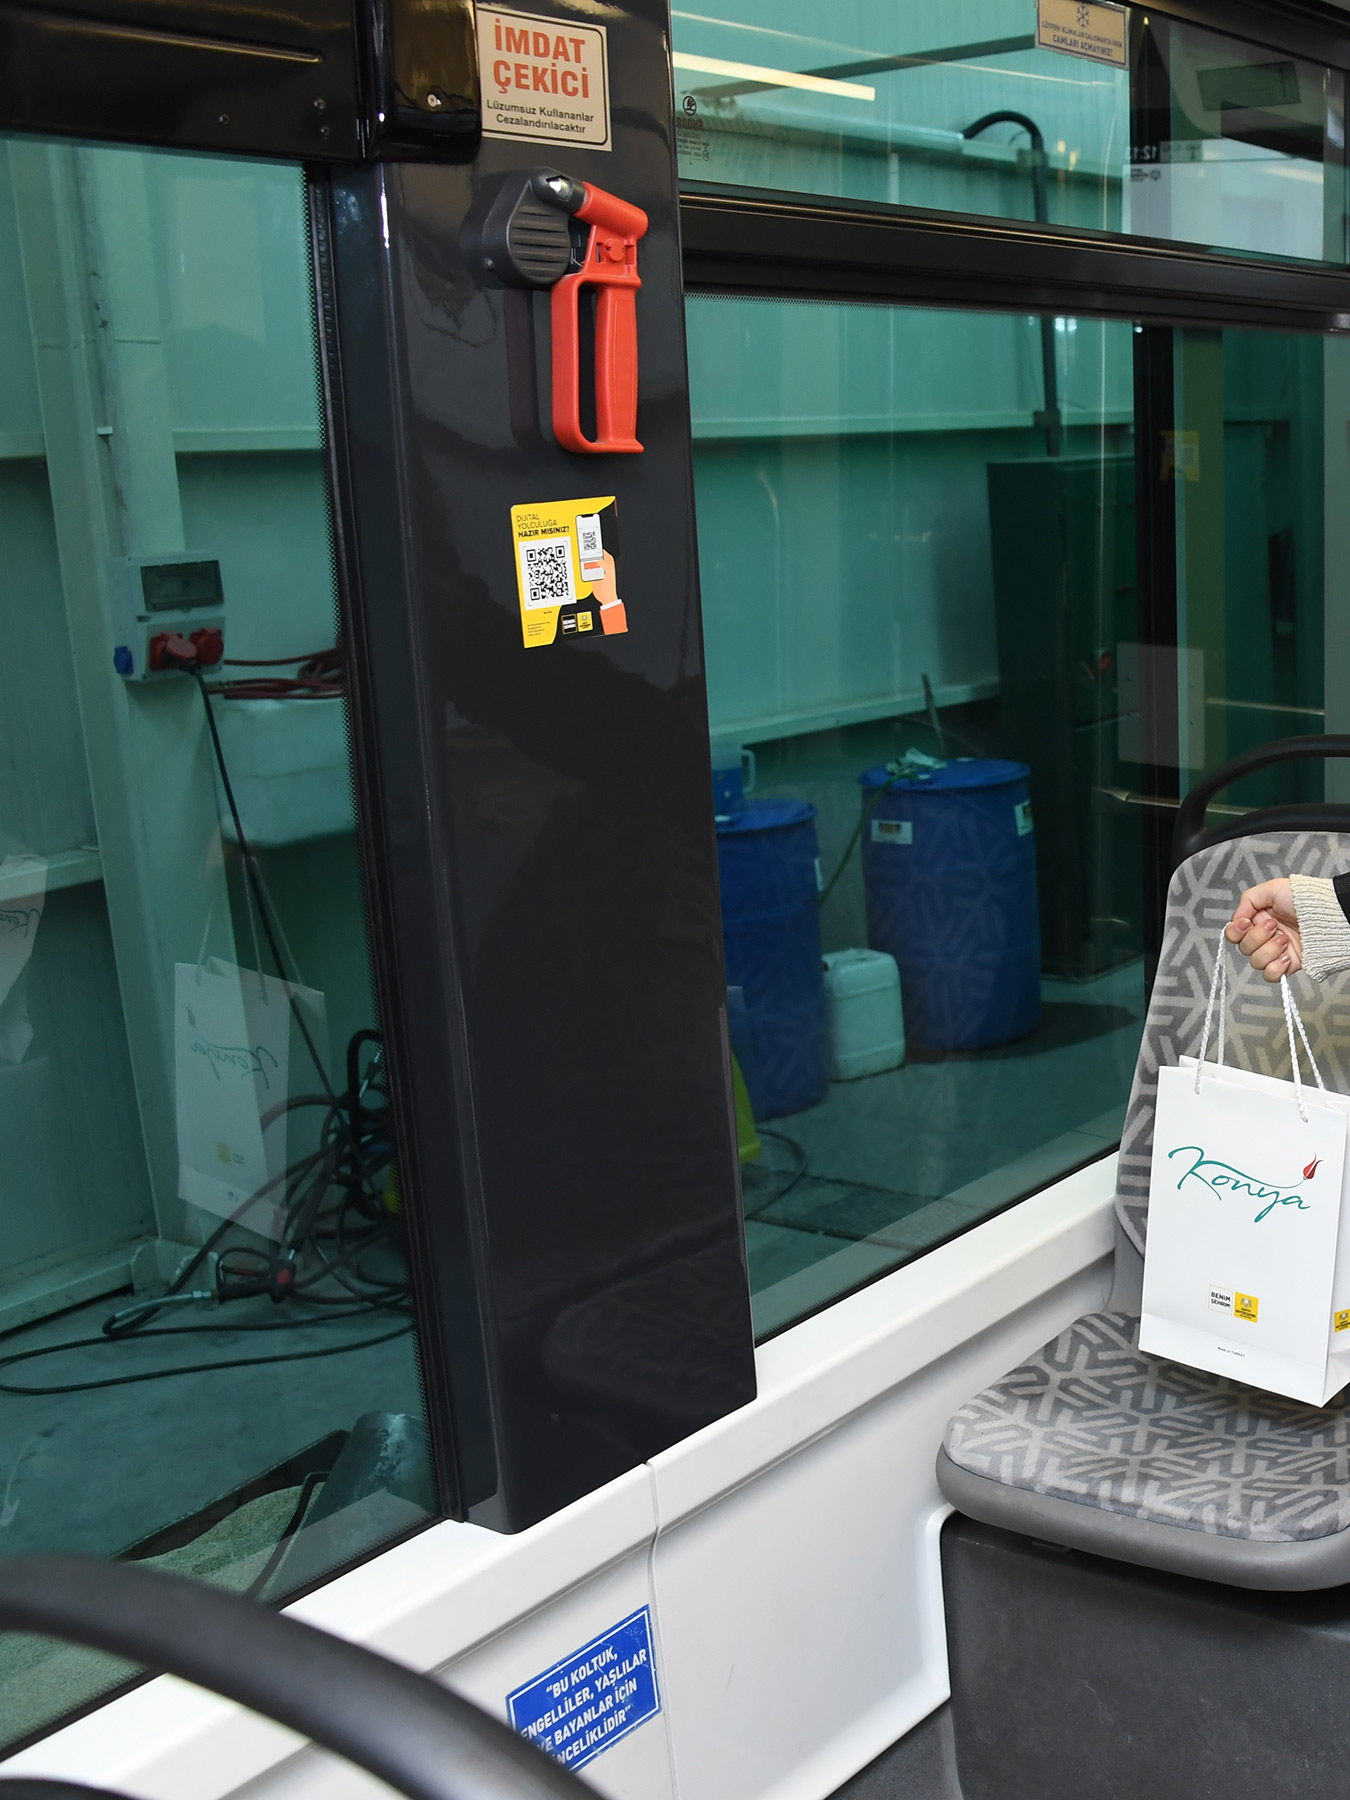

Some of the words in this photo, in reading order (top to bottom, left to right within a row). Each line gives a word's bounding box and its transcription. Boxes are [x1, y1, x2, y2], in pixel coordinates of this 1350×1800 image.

[495, 18, 586, 64] İMDAT
[493, 59, 590, 99] ÇEKİCİ
[486, 99, 537, 116] Lüzumsuz
[539, 106, 594, 122] Kullananlar
[496, 113, 586, 134] Cezalandırılacaktır
[517, 519, 558, 530] YOLCULUĞA
[518, 529, 539, 538] HAZIR
[541, 526, 570, 536] MISINIZ?
[1168, 1146, 1311, 1223] Konya
[571, 1646, 618, 1687] KOLTUK,
[520, 1686, 594, 1741] ENGELLİLER,
[594, 1648, 647, 1693] YAŞLILAR
[554, 1694, 613, 1745] BAYANLAR
[614, 1677, 637, 1704] İÇİN
[552, 1704, 631, 1765] NCELİKLİDİR”
